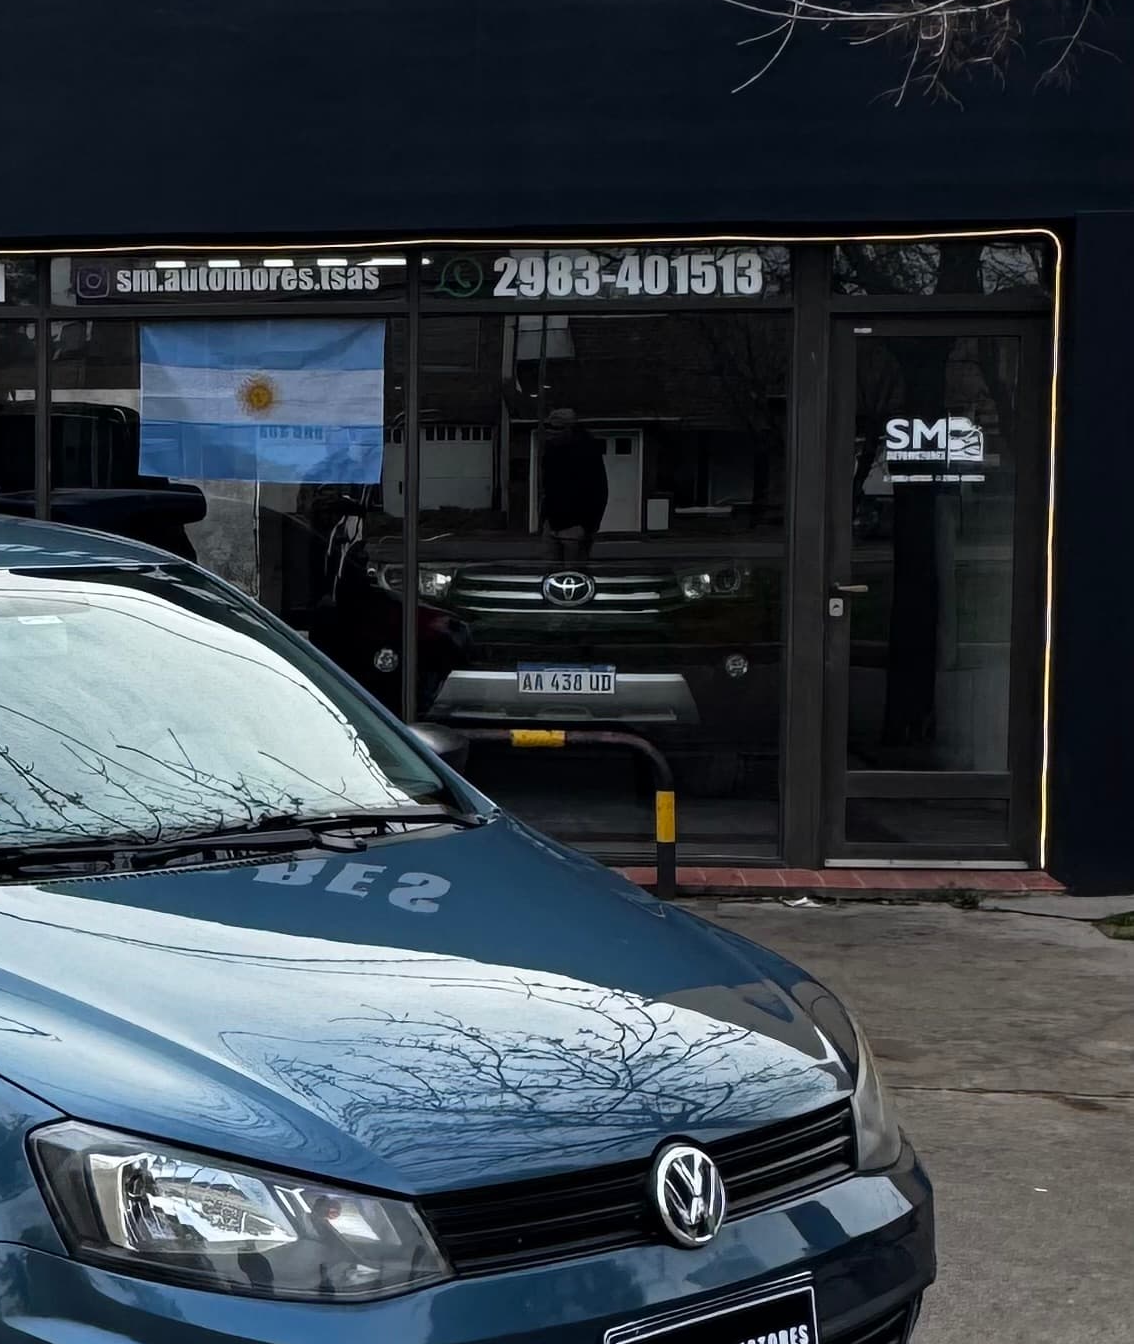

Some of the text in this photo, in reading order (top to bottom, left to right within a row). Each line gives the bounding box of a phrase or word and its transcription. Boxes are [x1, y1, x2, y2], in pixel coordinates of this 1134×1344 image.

[493, 254, 764, 296] 2983-401513
[885, 418, 947, 450] SM
[522, 673, 543, 691] AA
